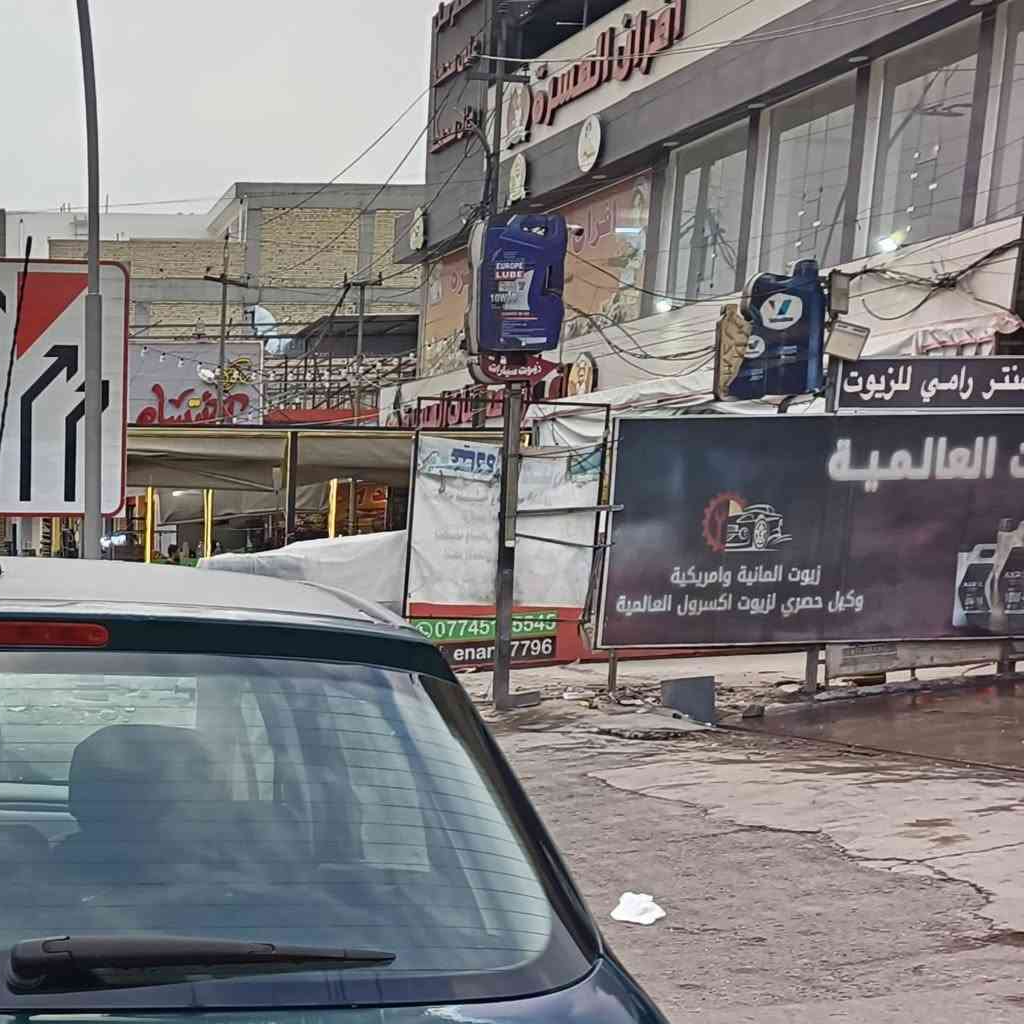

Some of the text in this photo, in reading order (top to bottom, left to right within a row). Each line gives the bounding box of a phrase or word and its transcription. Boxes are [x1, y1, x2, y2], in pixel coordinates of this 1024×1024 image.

[843, 365, 1024, 402] نتر رامي للزيوت
[828, 436, 997, 493] العالمية
[670, 565, 822, 588] زيوت المانية وامريكية
[616, 594, 672, 616] العالمية
[737, 593, 776, 614] لزيوت
[781, 597, 823, 617] حصري
[828, 589, 864, 613] وكيل
